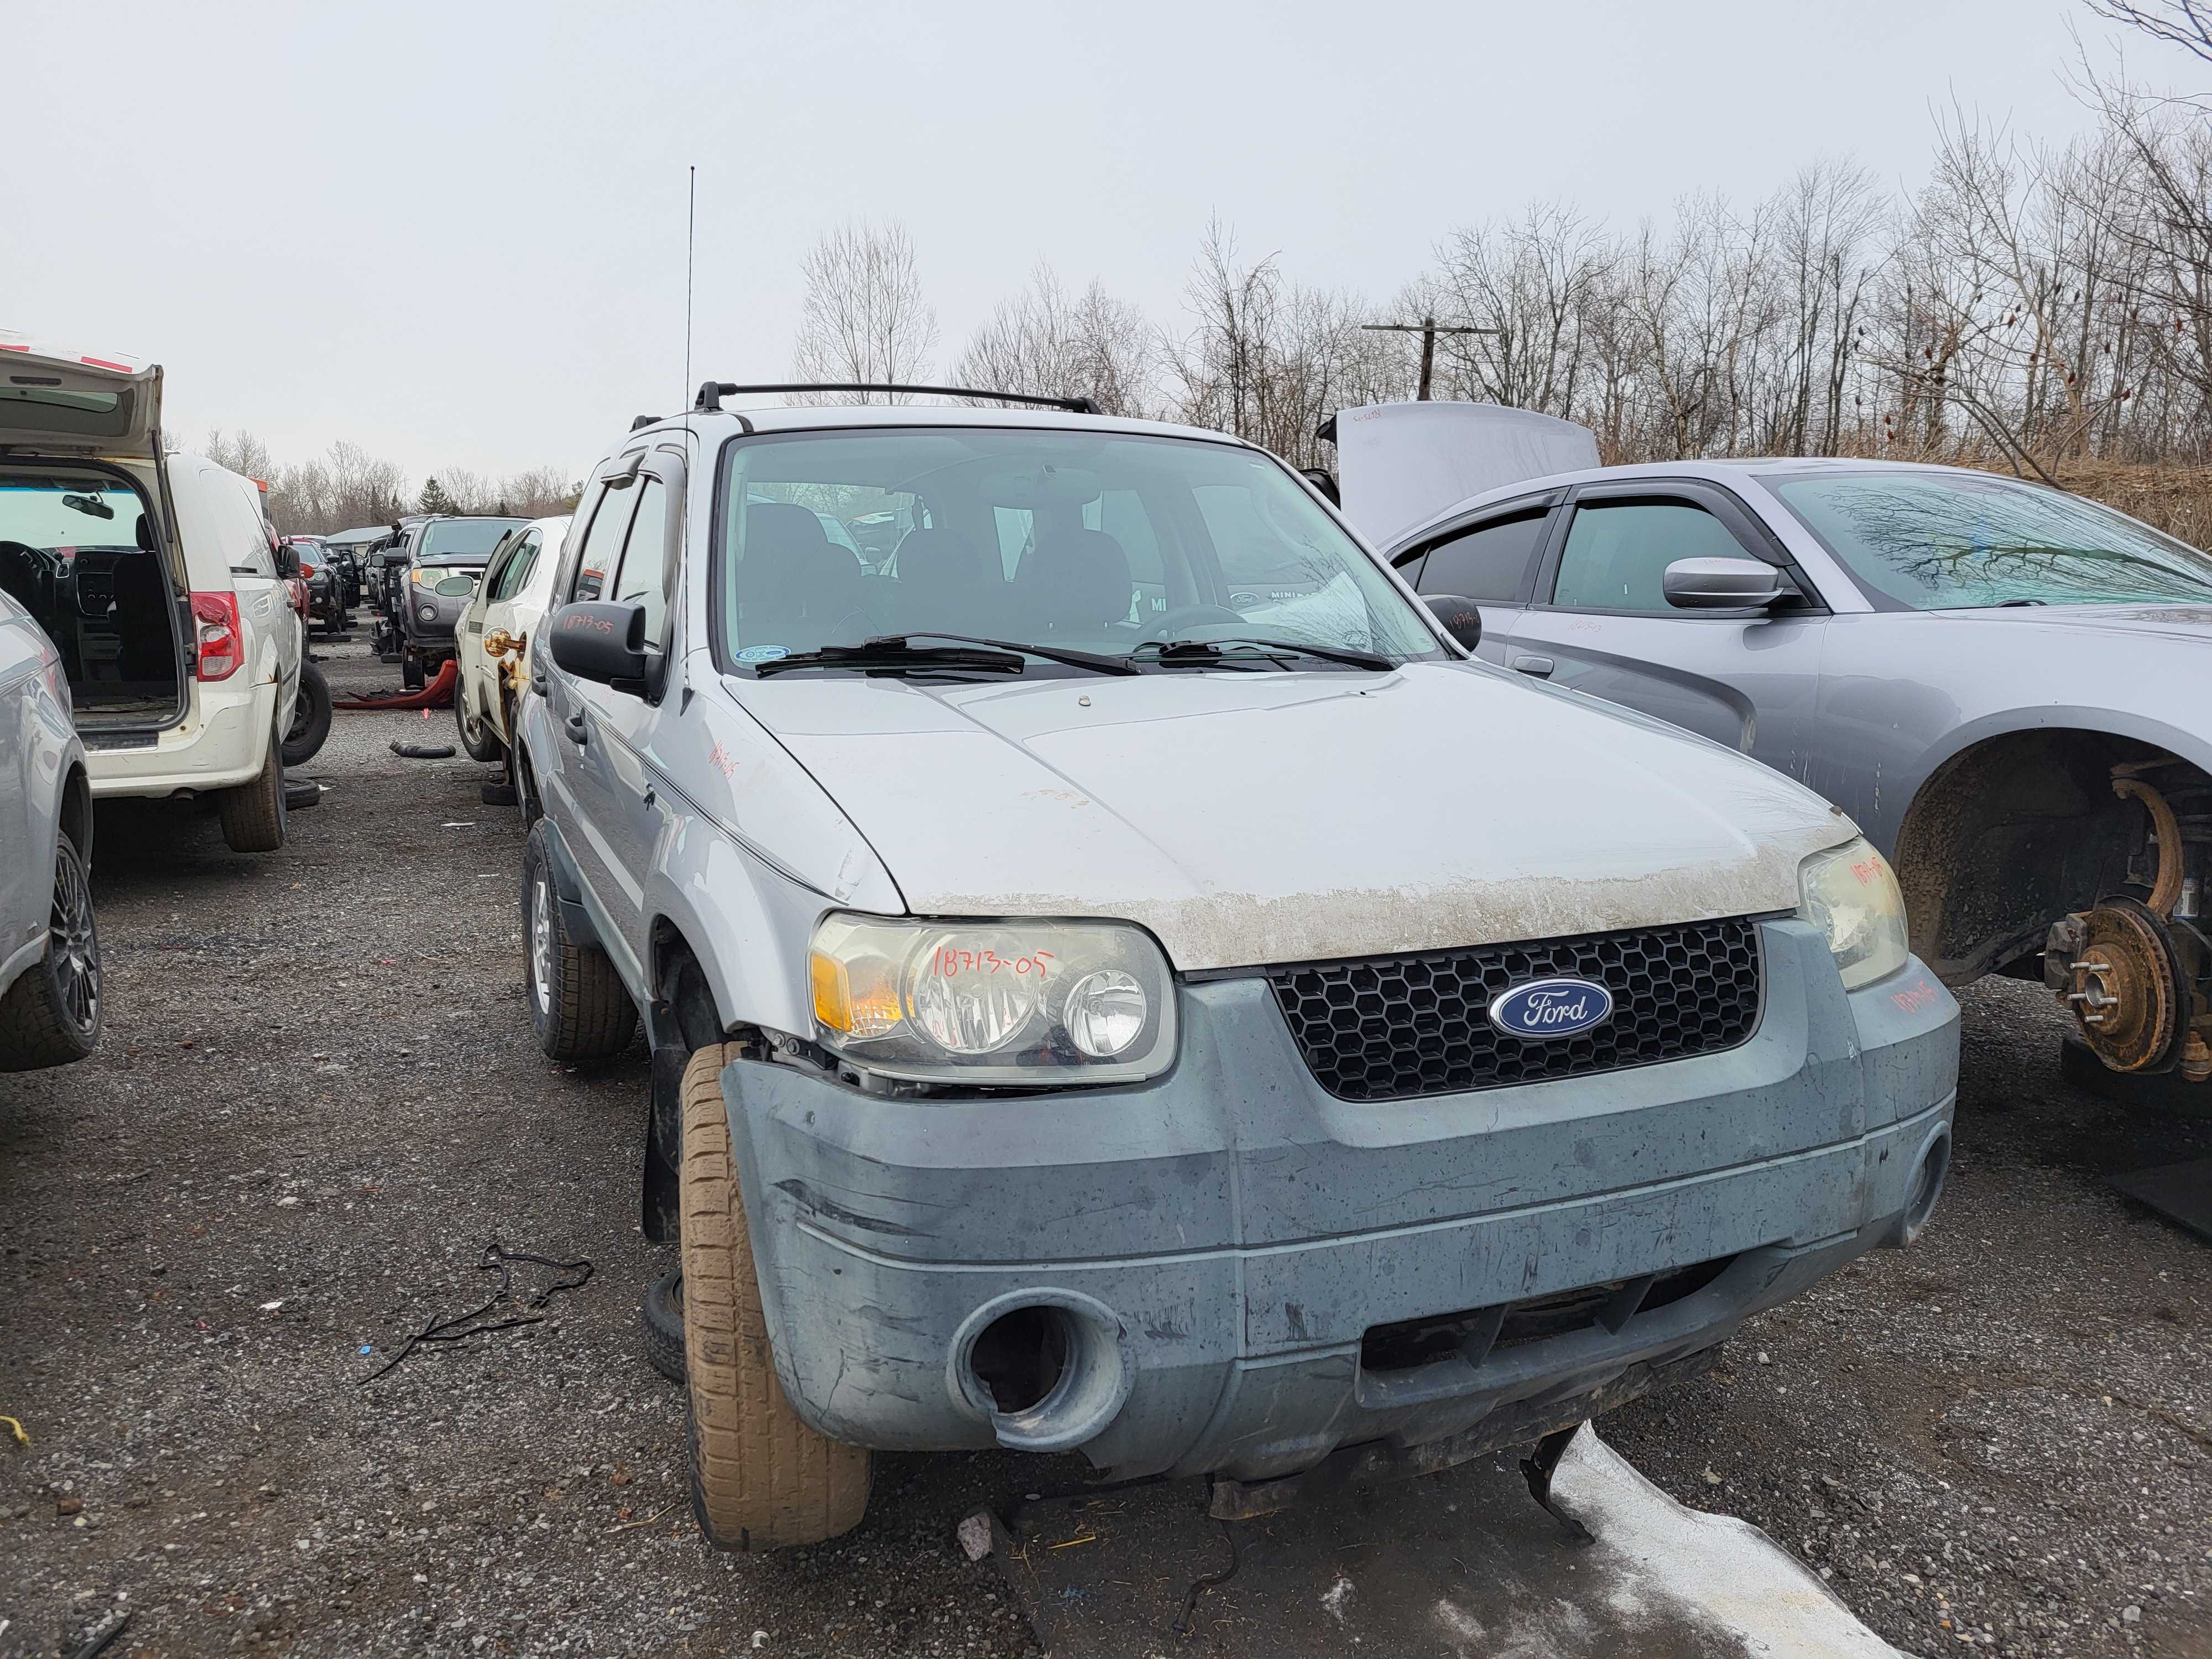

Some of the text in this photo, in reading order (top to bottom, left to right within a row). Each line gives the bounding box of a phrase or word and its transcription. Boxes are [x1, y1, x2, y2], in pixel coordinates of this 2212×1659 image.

[562, 614, 614, 634] 18713-05
[934, 946, 1054, 978] 18713-05
[1524, 990, 1588, 1026] Ford
